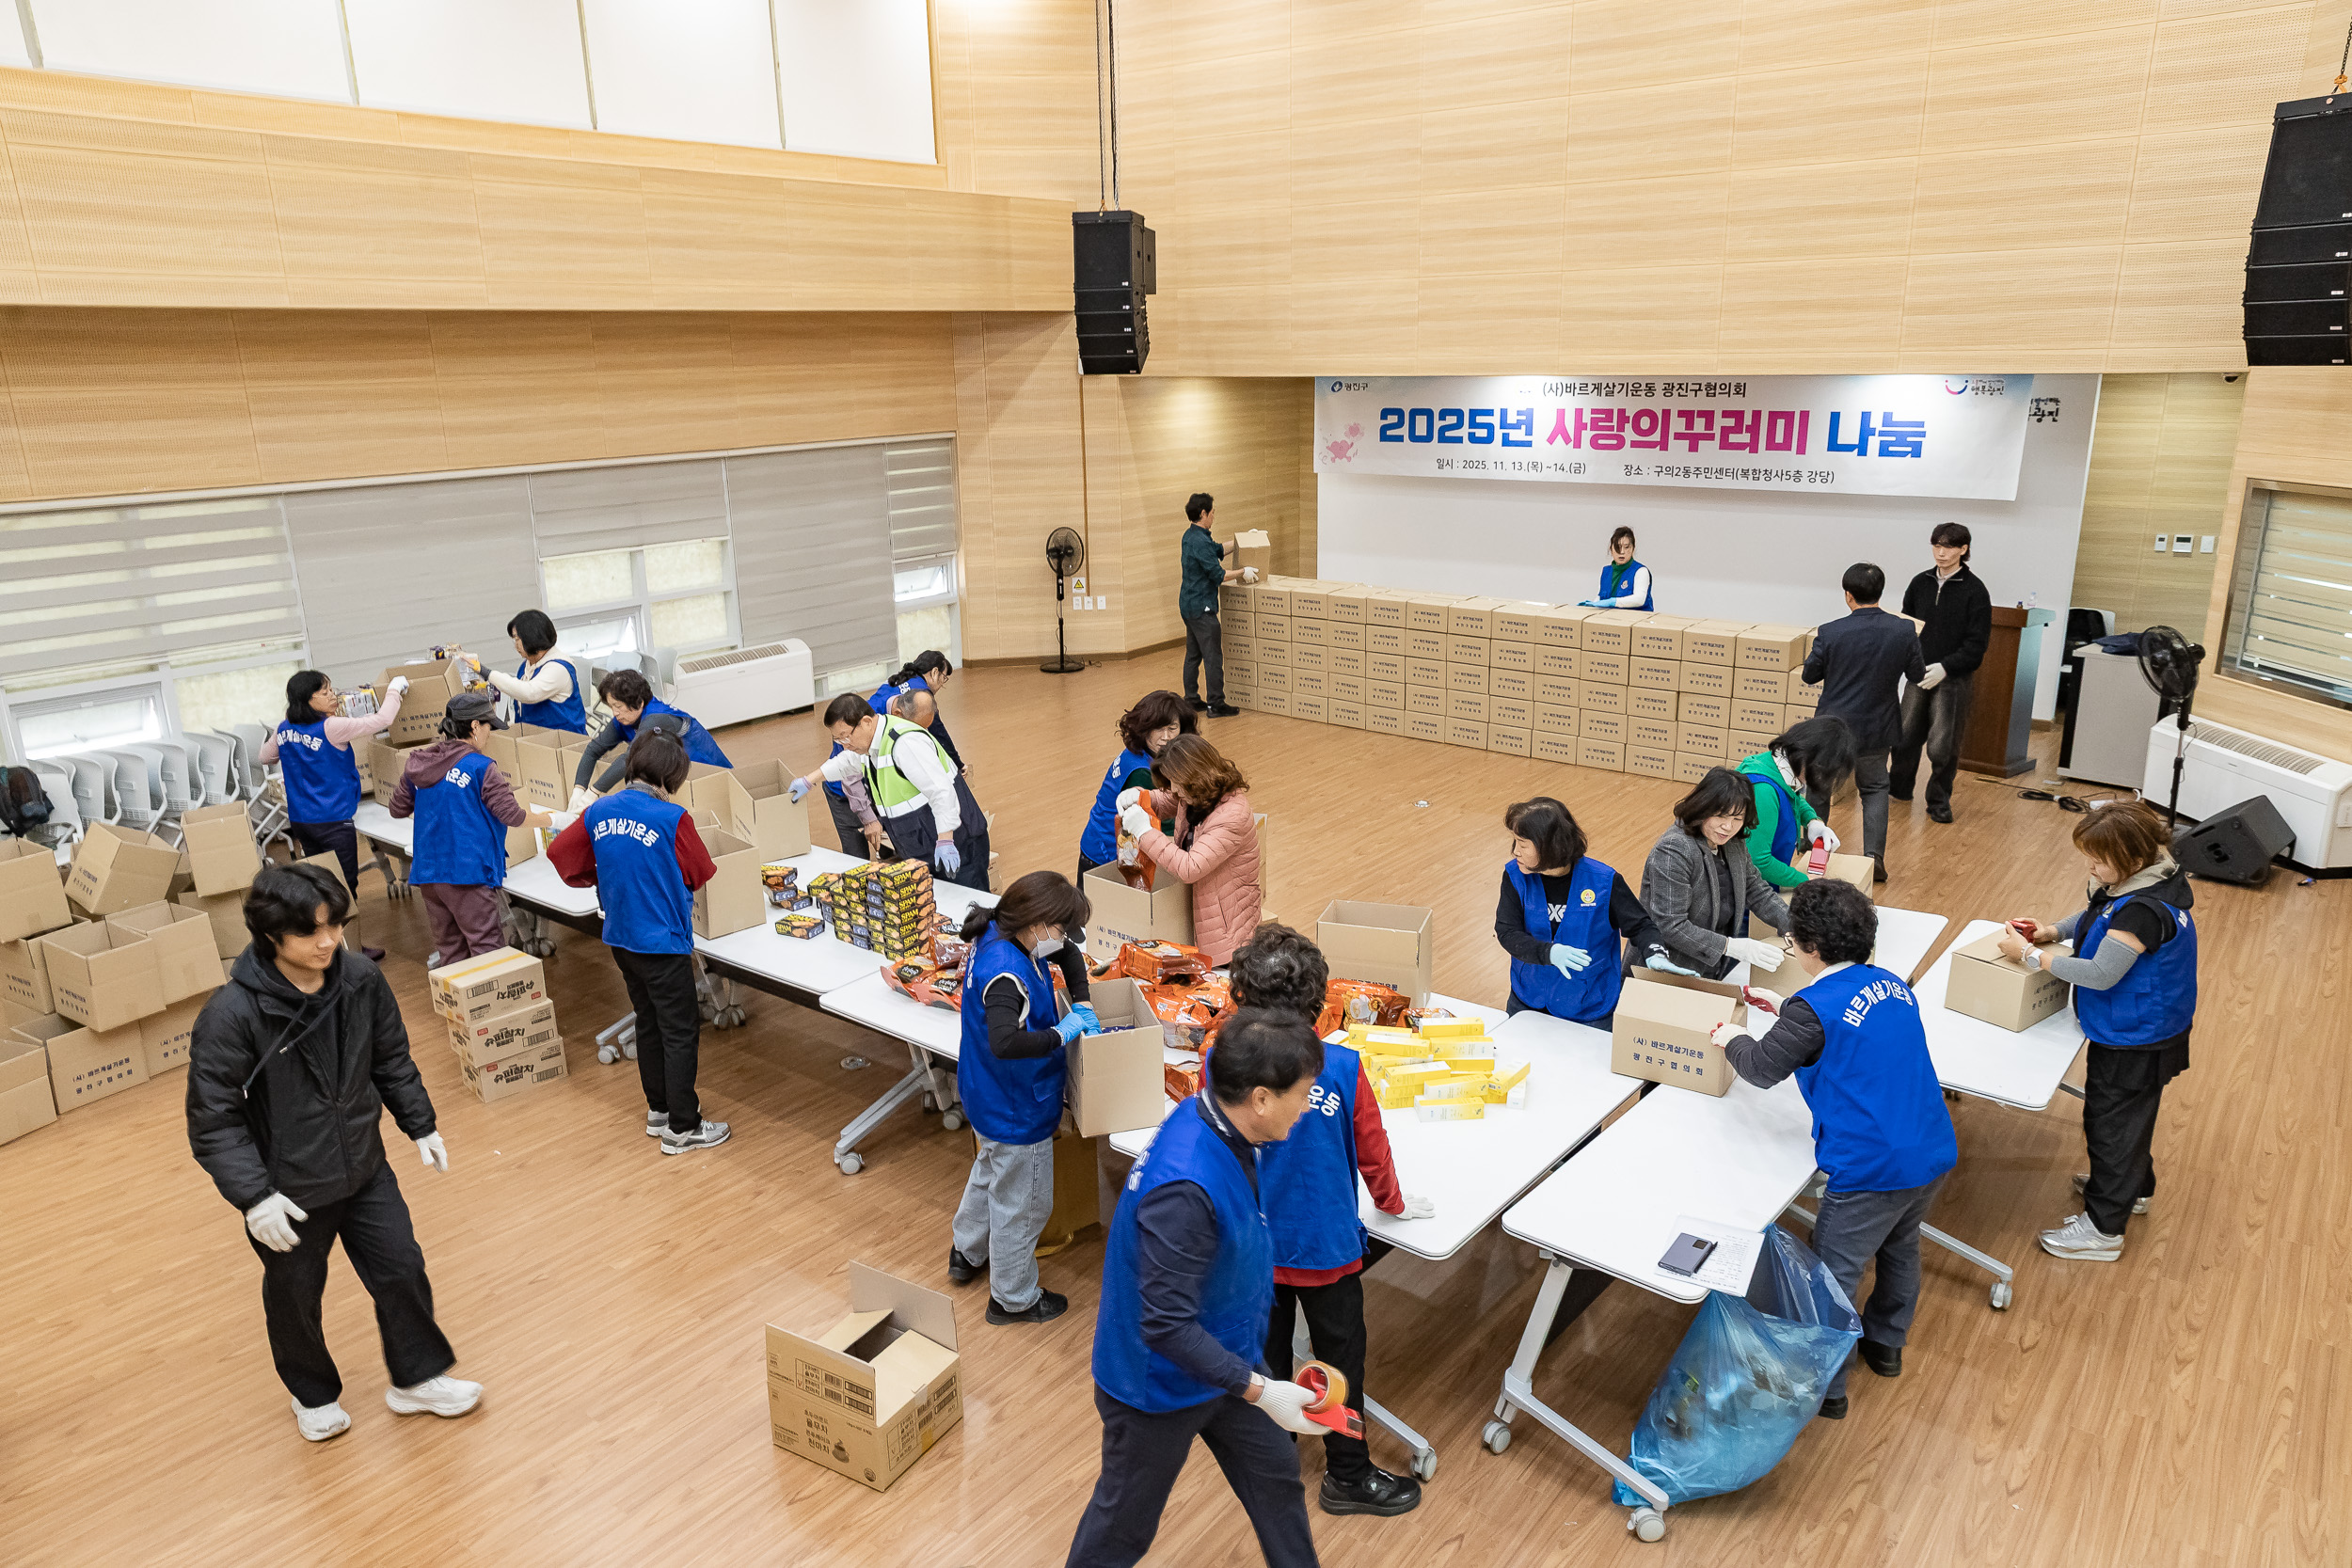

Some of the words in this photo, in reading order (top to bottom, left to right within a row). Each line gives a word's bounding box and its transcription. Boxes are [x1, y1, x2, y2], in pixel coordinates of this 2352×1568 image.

[1344, 382, 1369, 392] 광진구
[1543, 382, 1657, 398] (사)바르게살기운동
[1661, 382, 1747, 398] 광진구협의회
[1379, 407, 1534, 448] 2025년
[1546, 408, 1811, 455] 사랑의꾸러미
[1827, 411, 1927, 459] 나눔
[1436, 458, 1454, 470] 일시
[1462, 459, 1489, 470] 2025.
[1493, 460, 1507, 471] 11.
[1511, 460, 1543, 473] 13.(목)
[1623, 464, 1644, 477] 장소
[1653, 465, 1804, 483] 구의2동주민센터(복합청사5층
[1806, 469, 1836, 484] 강당)
[894, 871, 913, 883] SPAM
[899, 882, 917, 895] SPAM
[898, 895, 916, 908] SPAM
[901, 909, 919, 921] SPAM
[775, 923, 792, 932] SPAM
[899, 922, 917, 933] SPAM
[903, 933, 919, 946] SPAM
[904, 945, 920, 958] SPAM
[1842, 978, 1915, 1028] 바르게살기운동
[1633, 1036, 1647, 1046] (사)
[1651, 1040, 1705, 1060] 바르게살기운동
